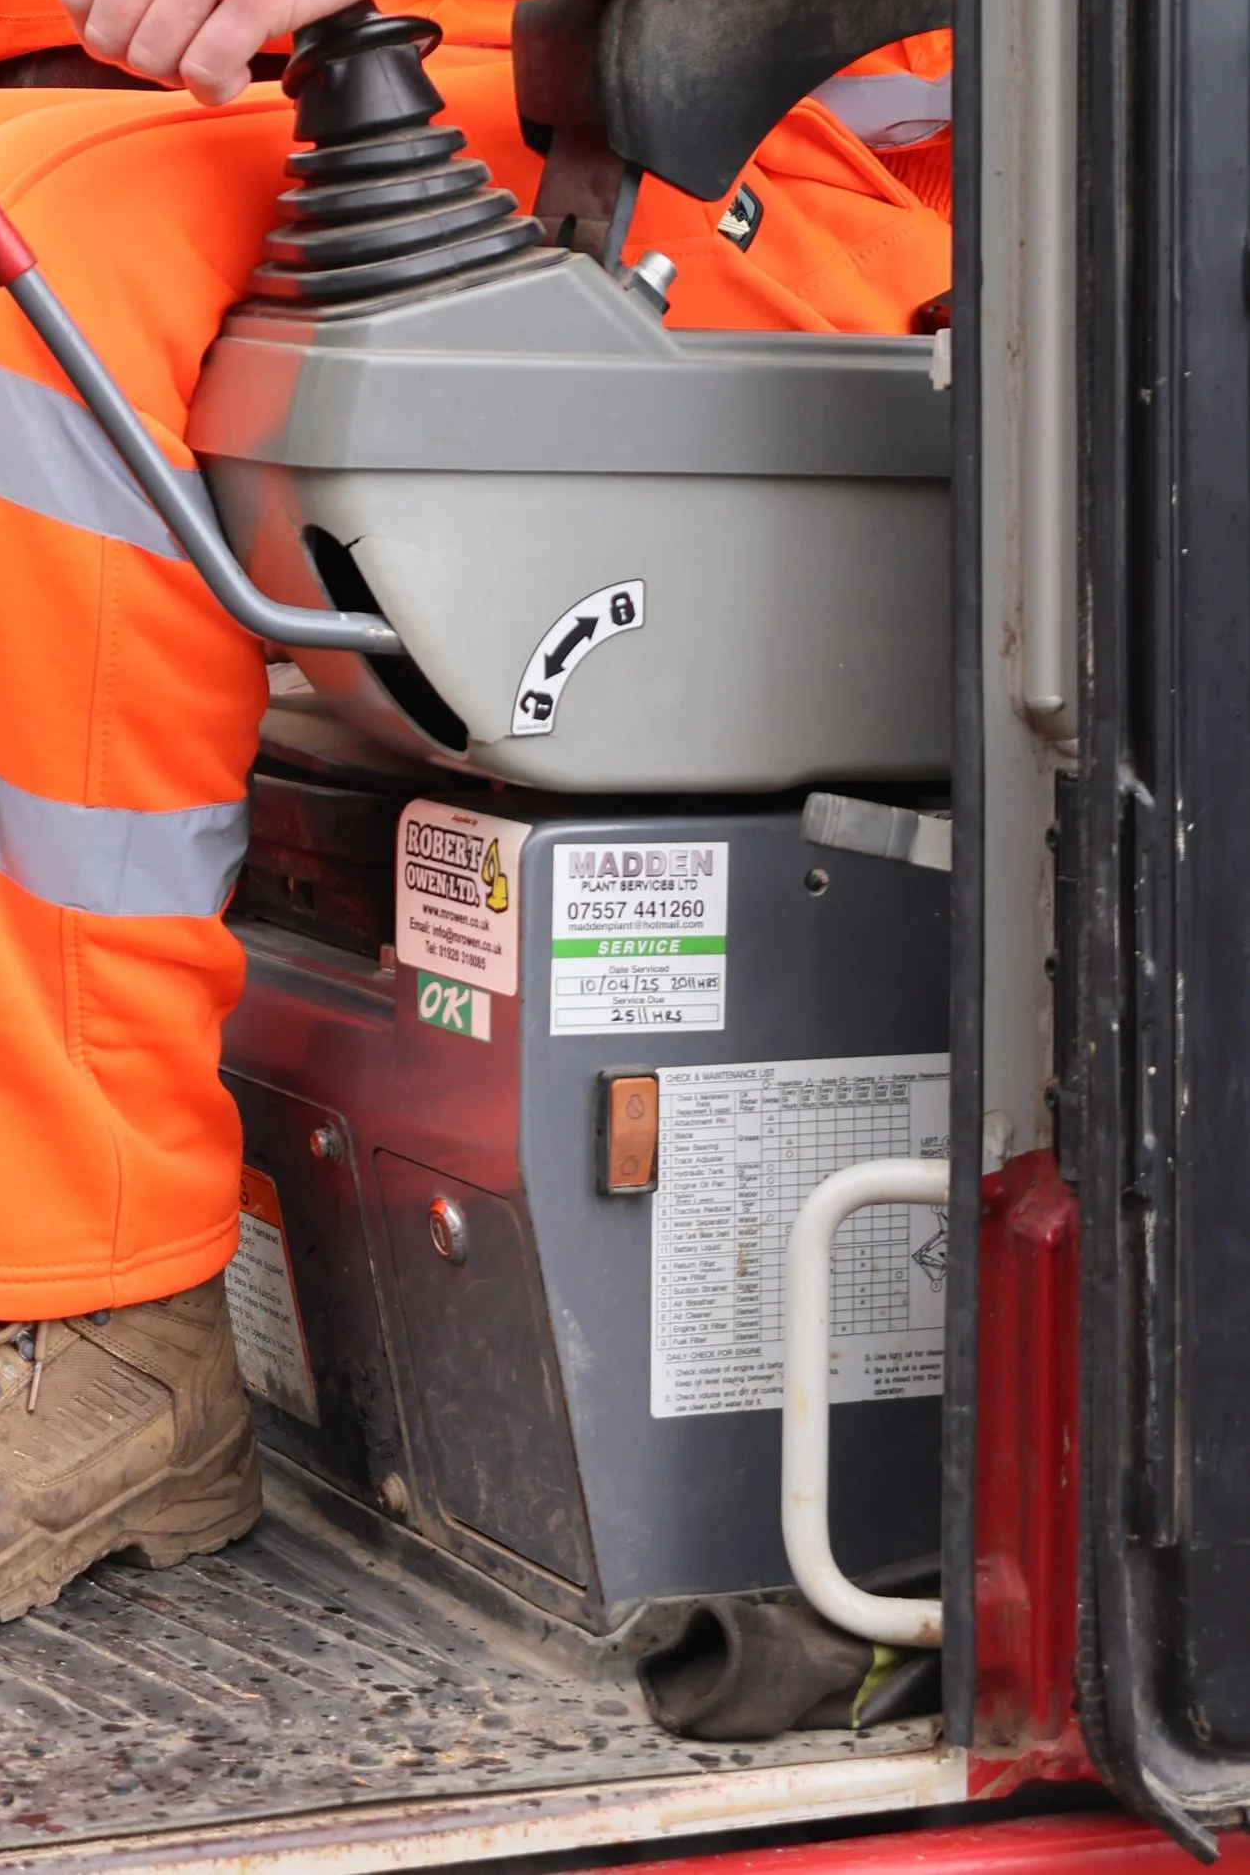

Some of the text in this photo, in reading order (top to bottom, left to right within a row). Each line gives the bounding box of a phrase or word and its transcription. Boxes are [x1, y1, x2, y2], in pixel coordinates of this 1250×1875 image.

[406, 820, 484, 872] ROBERT
[569, 849, 713, 878] MADDEN
[405, 861, 448, 899] OWEN
[582, 880, 698, 892] PLANT SERVICES LTD
[568, 900, 704, 920] 07557 441260
[422, 904, 490, 931] www.mrowen.co.uk
[568, 920, 704, 932] maddenplant@hotmail.com
[410, 916, 502, 955] Email: info@mrowen.co.uk
[425, 940, 437, 956] Tel:
[598, 940, 681, 954] SERVICE
[609, 964, 670, 974] Date Serviced
[580, 975, 660, 995] 10/04/25
[420, 982, 470, 1029] OK
[613, 996, 665, 1004] Service Due
[612, 1008, 682, 1024] 2511 HRS
[666, 1068, 775, 1082] CHECK & MAINTENANCE LIST
[674, 1118, 713, 1126] Attachment
[920, 1136, 938, 1144] LEFT
[920, 1148, 942, 1156] RIGHT
[674, 1170, 704, 1178] Hydraulic
[666, 1346, 762, 1360] DAILY CHECK FOR ENGINE
[733, 1364, 754, 1373] engine
[675, 1380, 692, 1388] Keep
[722, 1376, 745, 1384] staying
[747, 1373, 774, 1382] between
[760, 1386, 784, 1394] cooling
